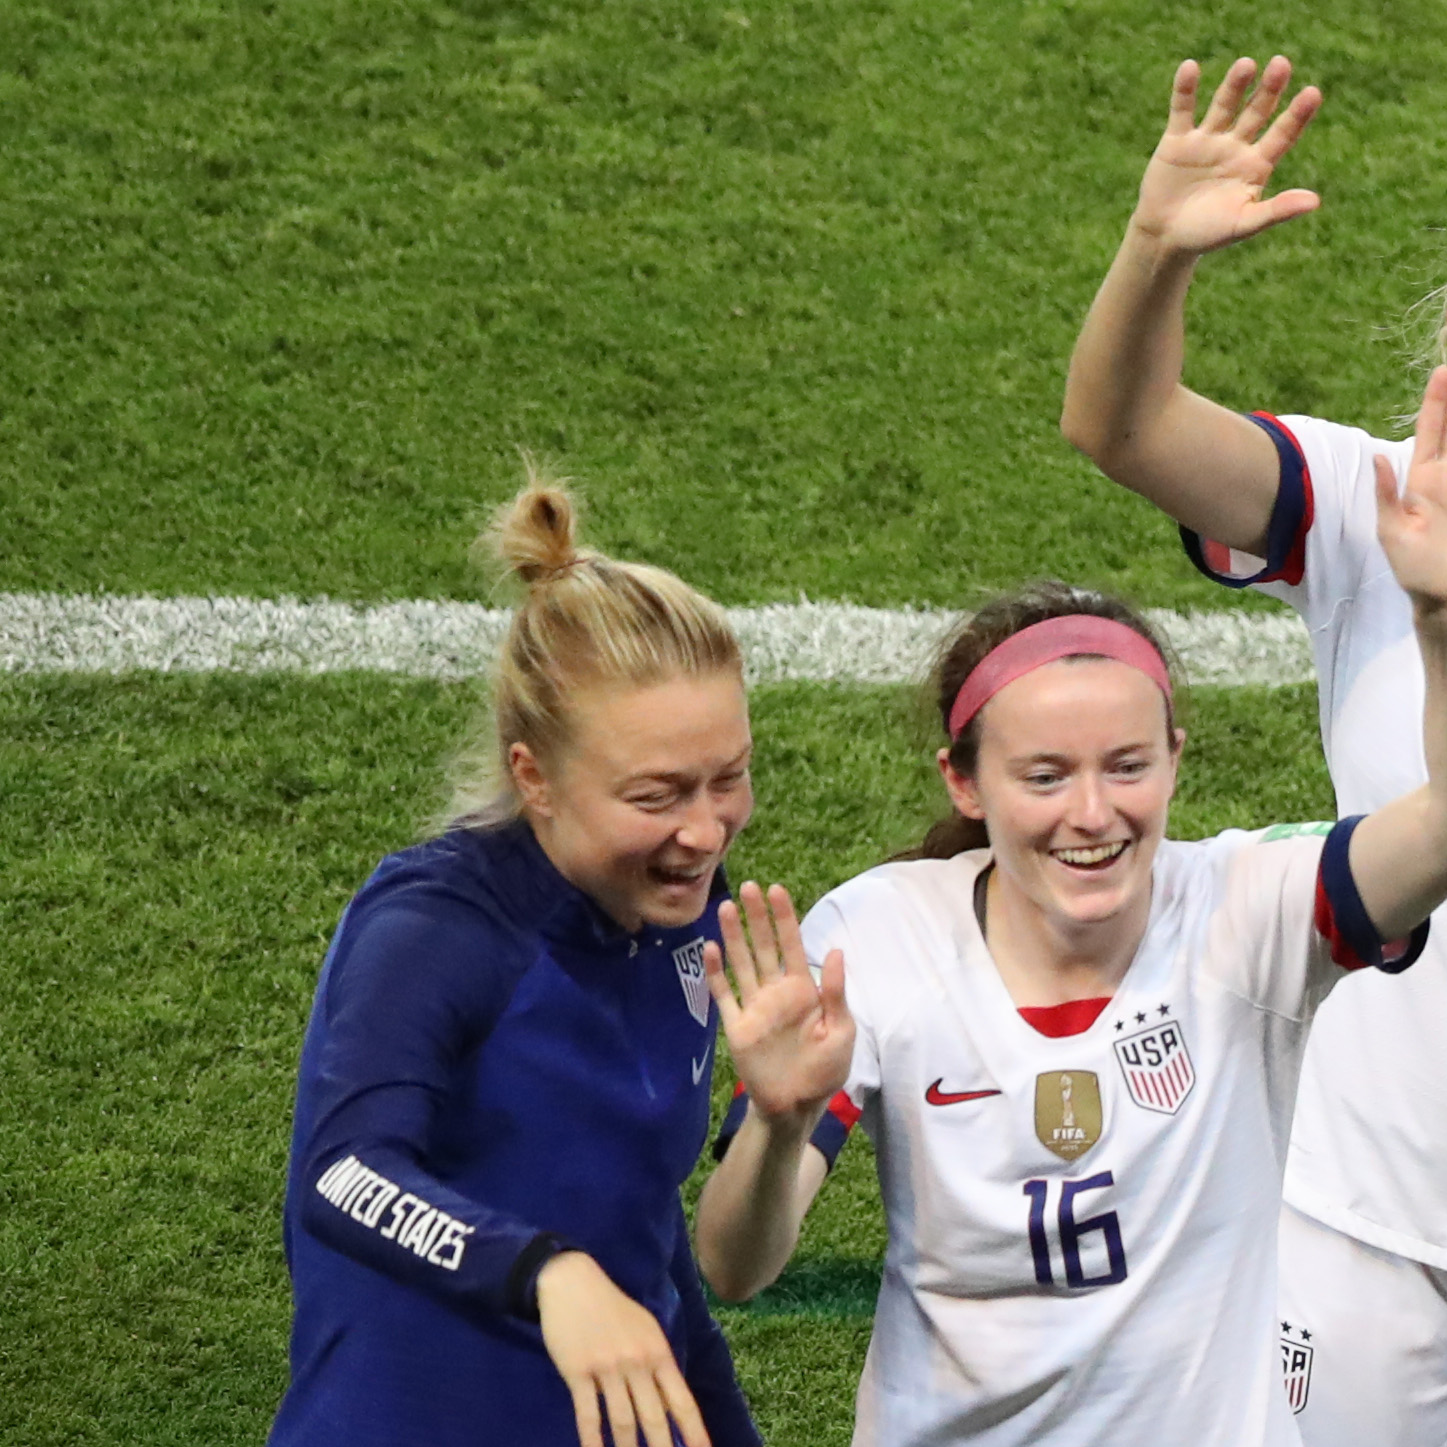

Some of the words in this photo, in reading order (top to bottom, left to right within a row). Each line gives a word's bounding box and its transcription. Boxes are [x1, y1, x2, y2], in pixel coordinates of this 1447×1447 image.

[1121, 1028, 1178, 1067] USA
[1053, 1127, 1086, 1140] FIFA
[315, 1154, 400, 1229] UNITED
[380, 1192, 476, 1272] STATES
[1022, 1170, 1128, 1289] 16
